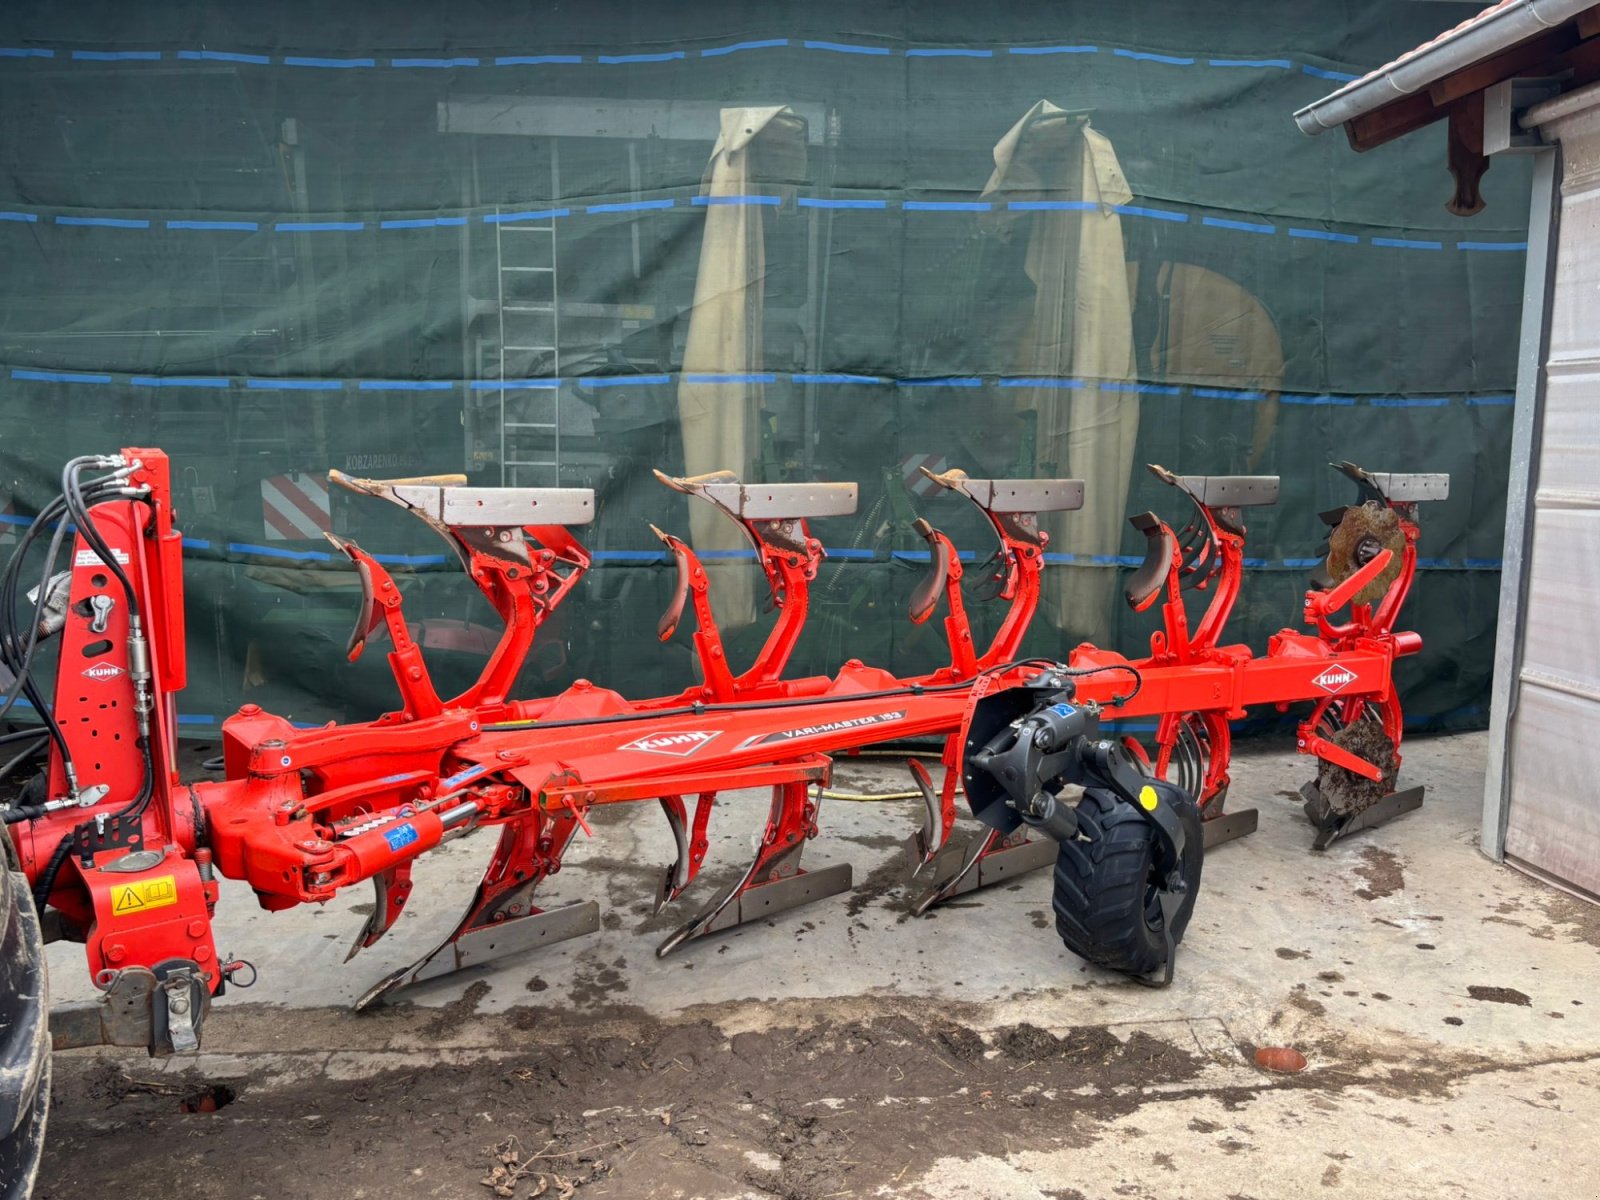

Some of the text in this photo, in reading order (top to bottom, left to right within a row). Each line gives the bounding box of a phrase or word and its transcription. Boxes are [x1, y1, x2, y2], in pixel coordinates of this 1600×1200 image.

[88, 667, 119, 677] KUHN
[1319, 672, 1351, 686] KUHN
[781, 711, 902, 738] VARI-MASTER 153
[633, 731, 710, 751] KUHN
